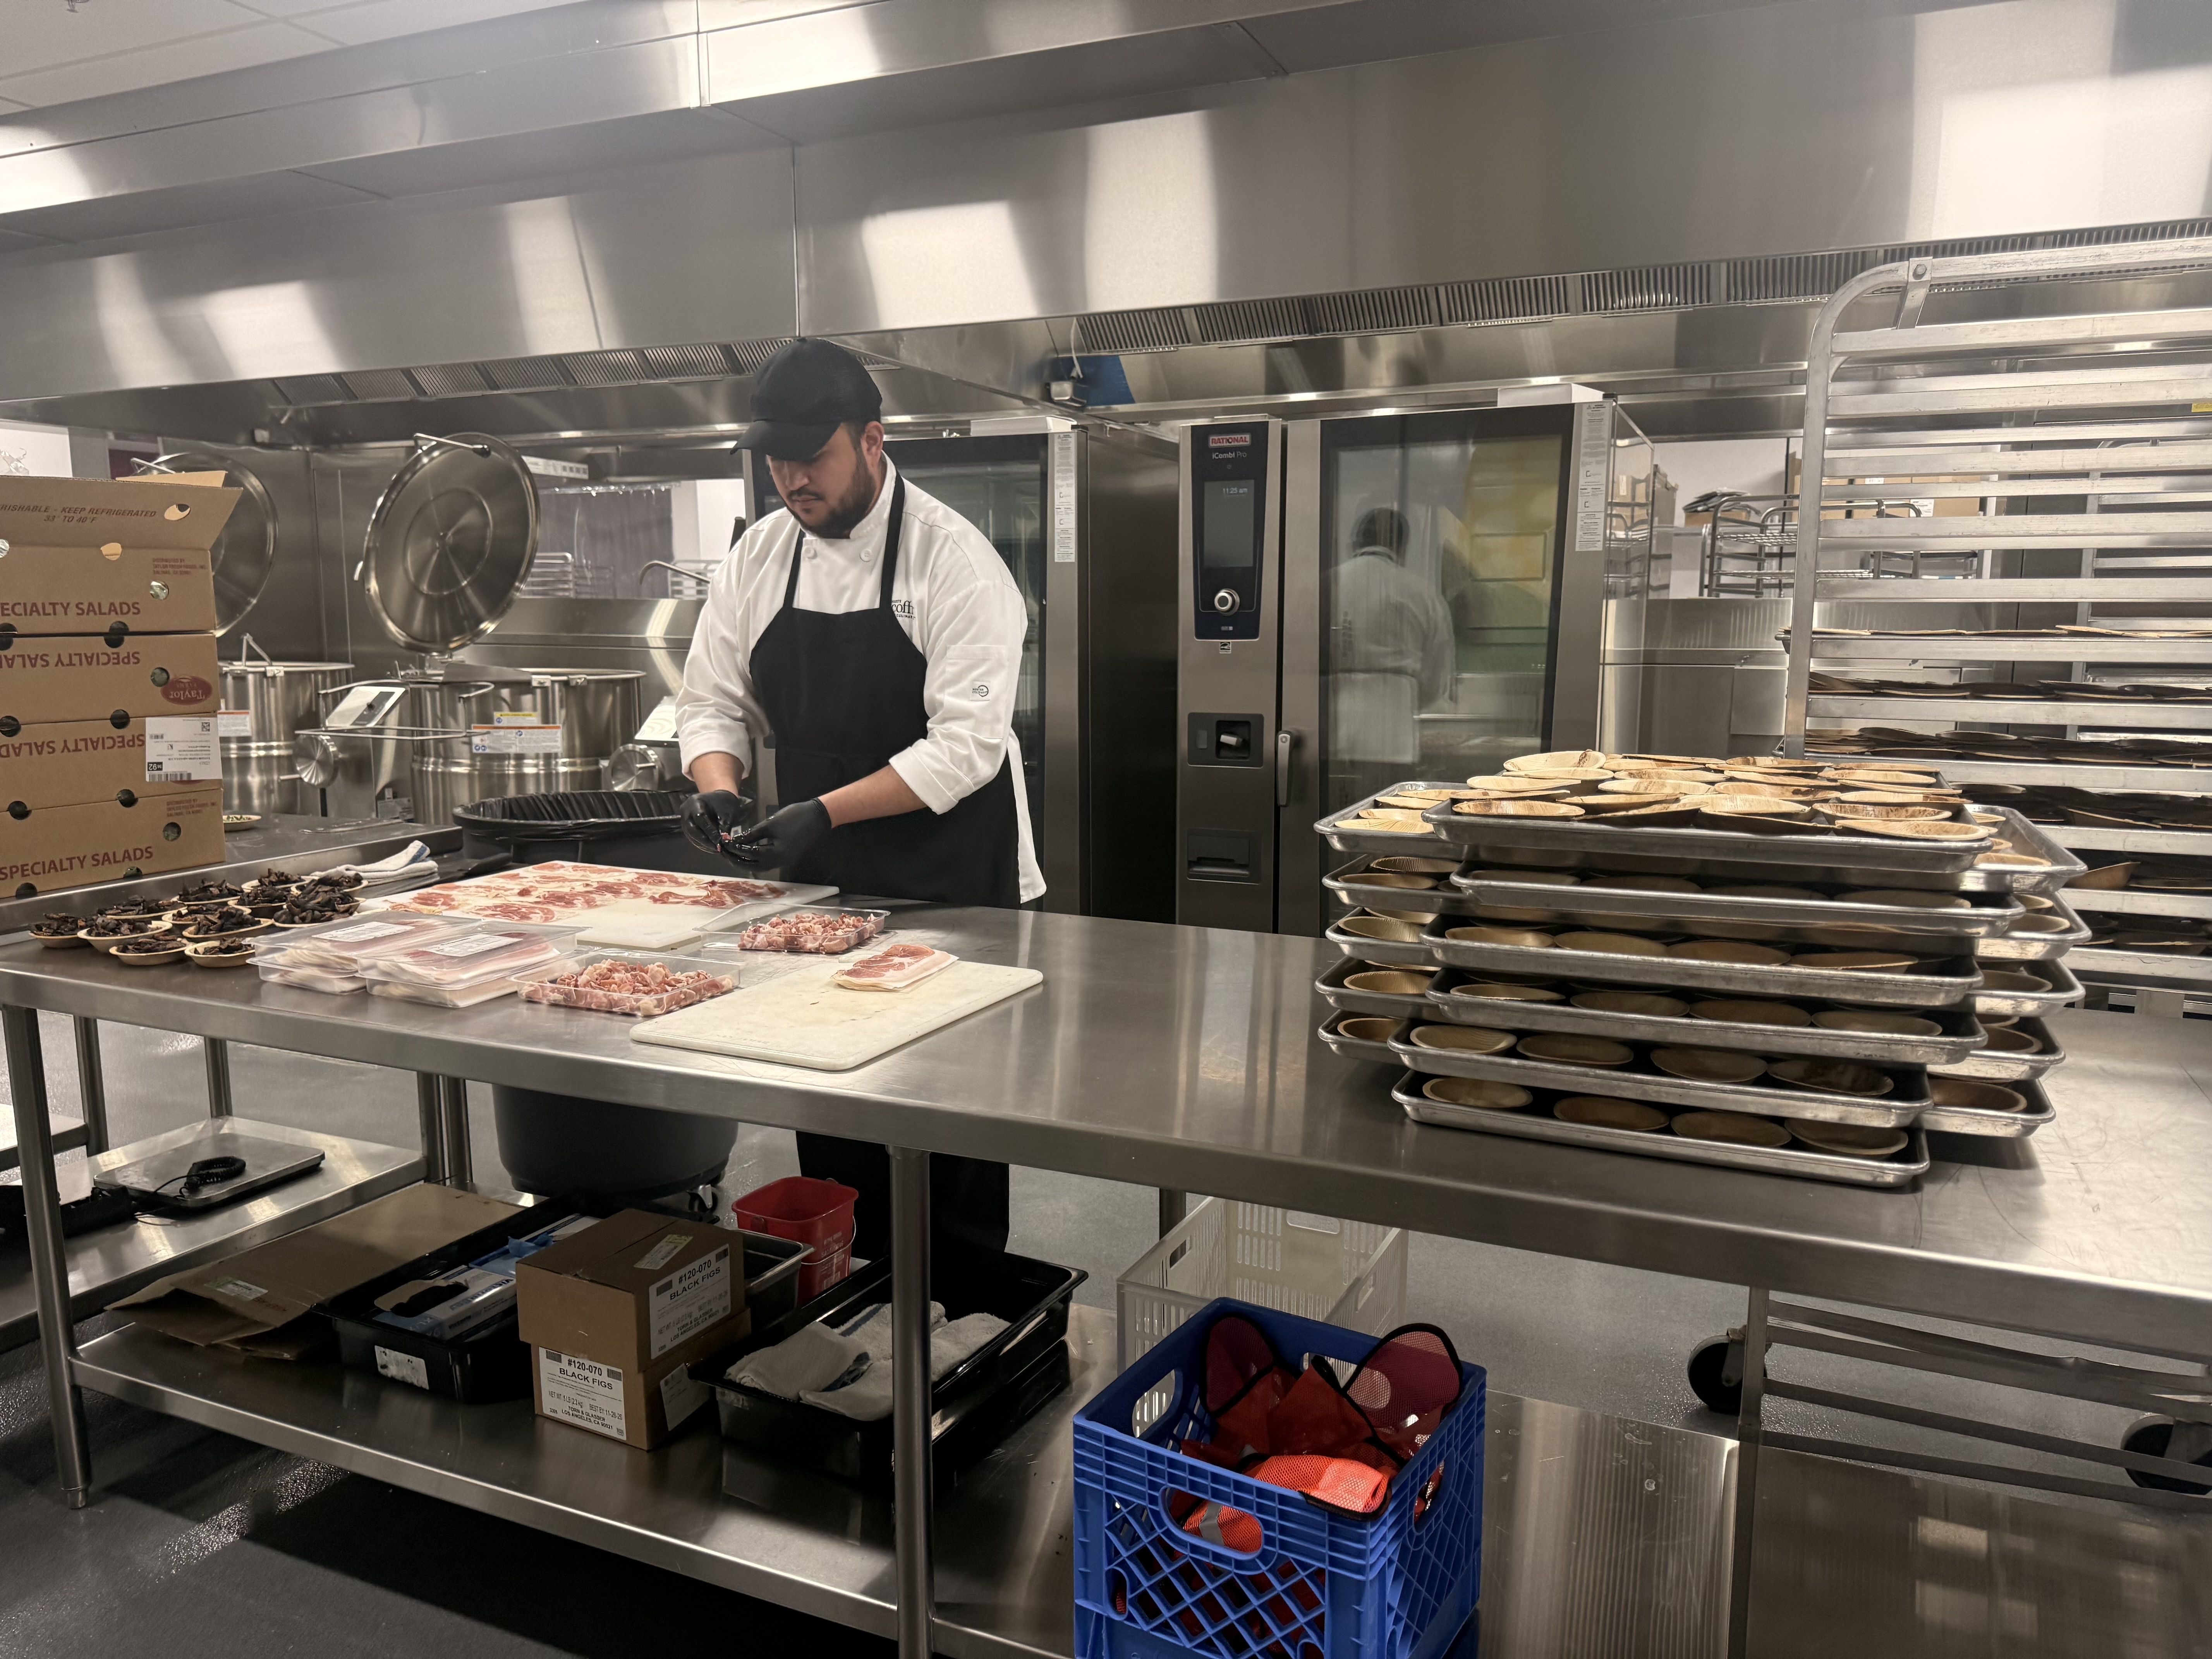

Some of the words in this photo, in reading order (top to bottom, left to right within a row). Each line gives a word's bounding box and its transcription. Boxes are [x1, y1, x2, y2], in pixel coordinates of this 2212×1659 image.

[1211, 436, 1248, 444] RATIONAL
[0, 505, 49, 513] RISHABLE
[88, 507, 156, 517] REFRIGERATED
[0, 602, 70, 616] ECIALTY
[76, 602, 141, 615] SALADS
[0, 654, 50, 668] SALA
[55, 651, 140, 667] SPECIALTY
[169, 689, 205, 700] Taylor
[0, 740, 56, 758] SALAD
[61, 734, 145, 753] SPECIALTY
[0, 855, 87, 881] SPECIALTY
[92, 846, 153, 867] SALADS
[678, 1259, 711, 1284] #120-070
[670, 1279, 699, 1300] BLACK
[702, 1267, 721, 1283] FIGS
[670, 1333, 680, 1342] LOS
[567, 1358, 602, 1376] #120-070
[559, 1368, 590, 1383] BLACK
[592, 1378, 613, 1390] FIGS
